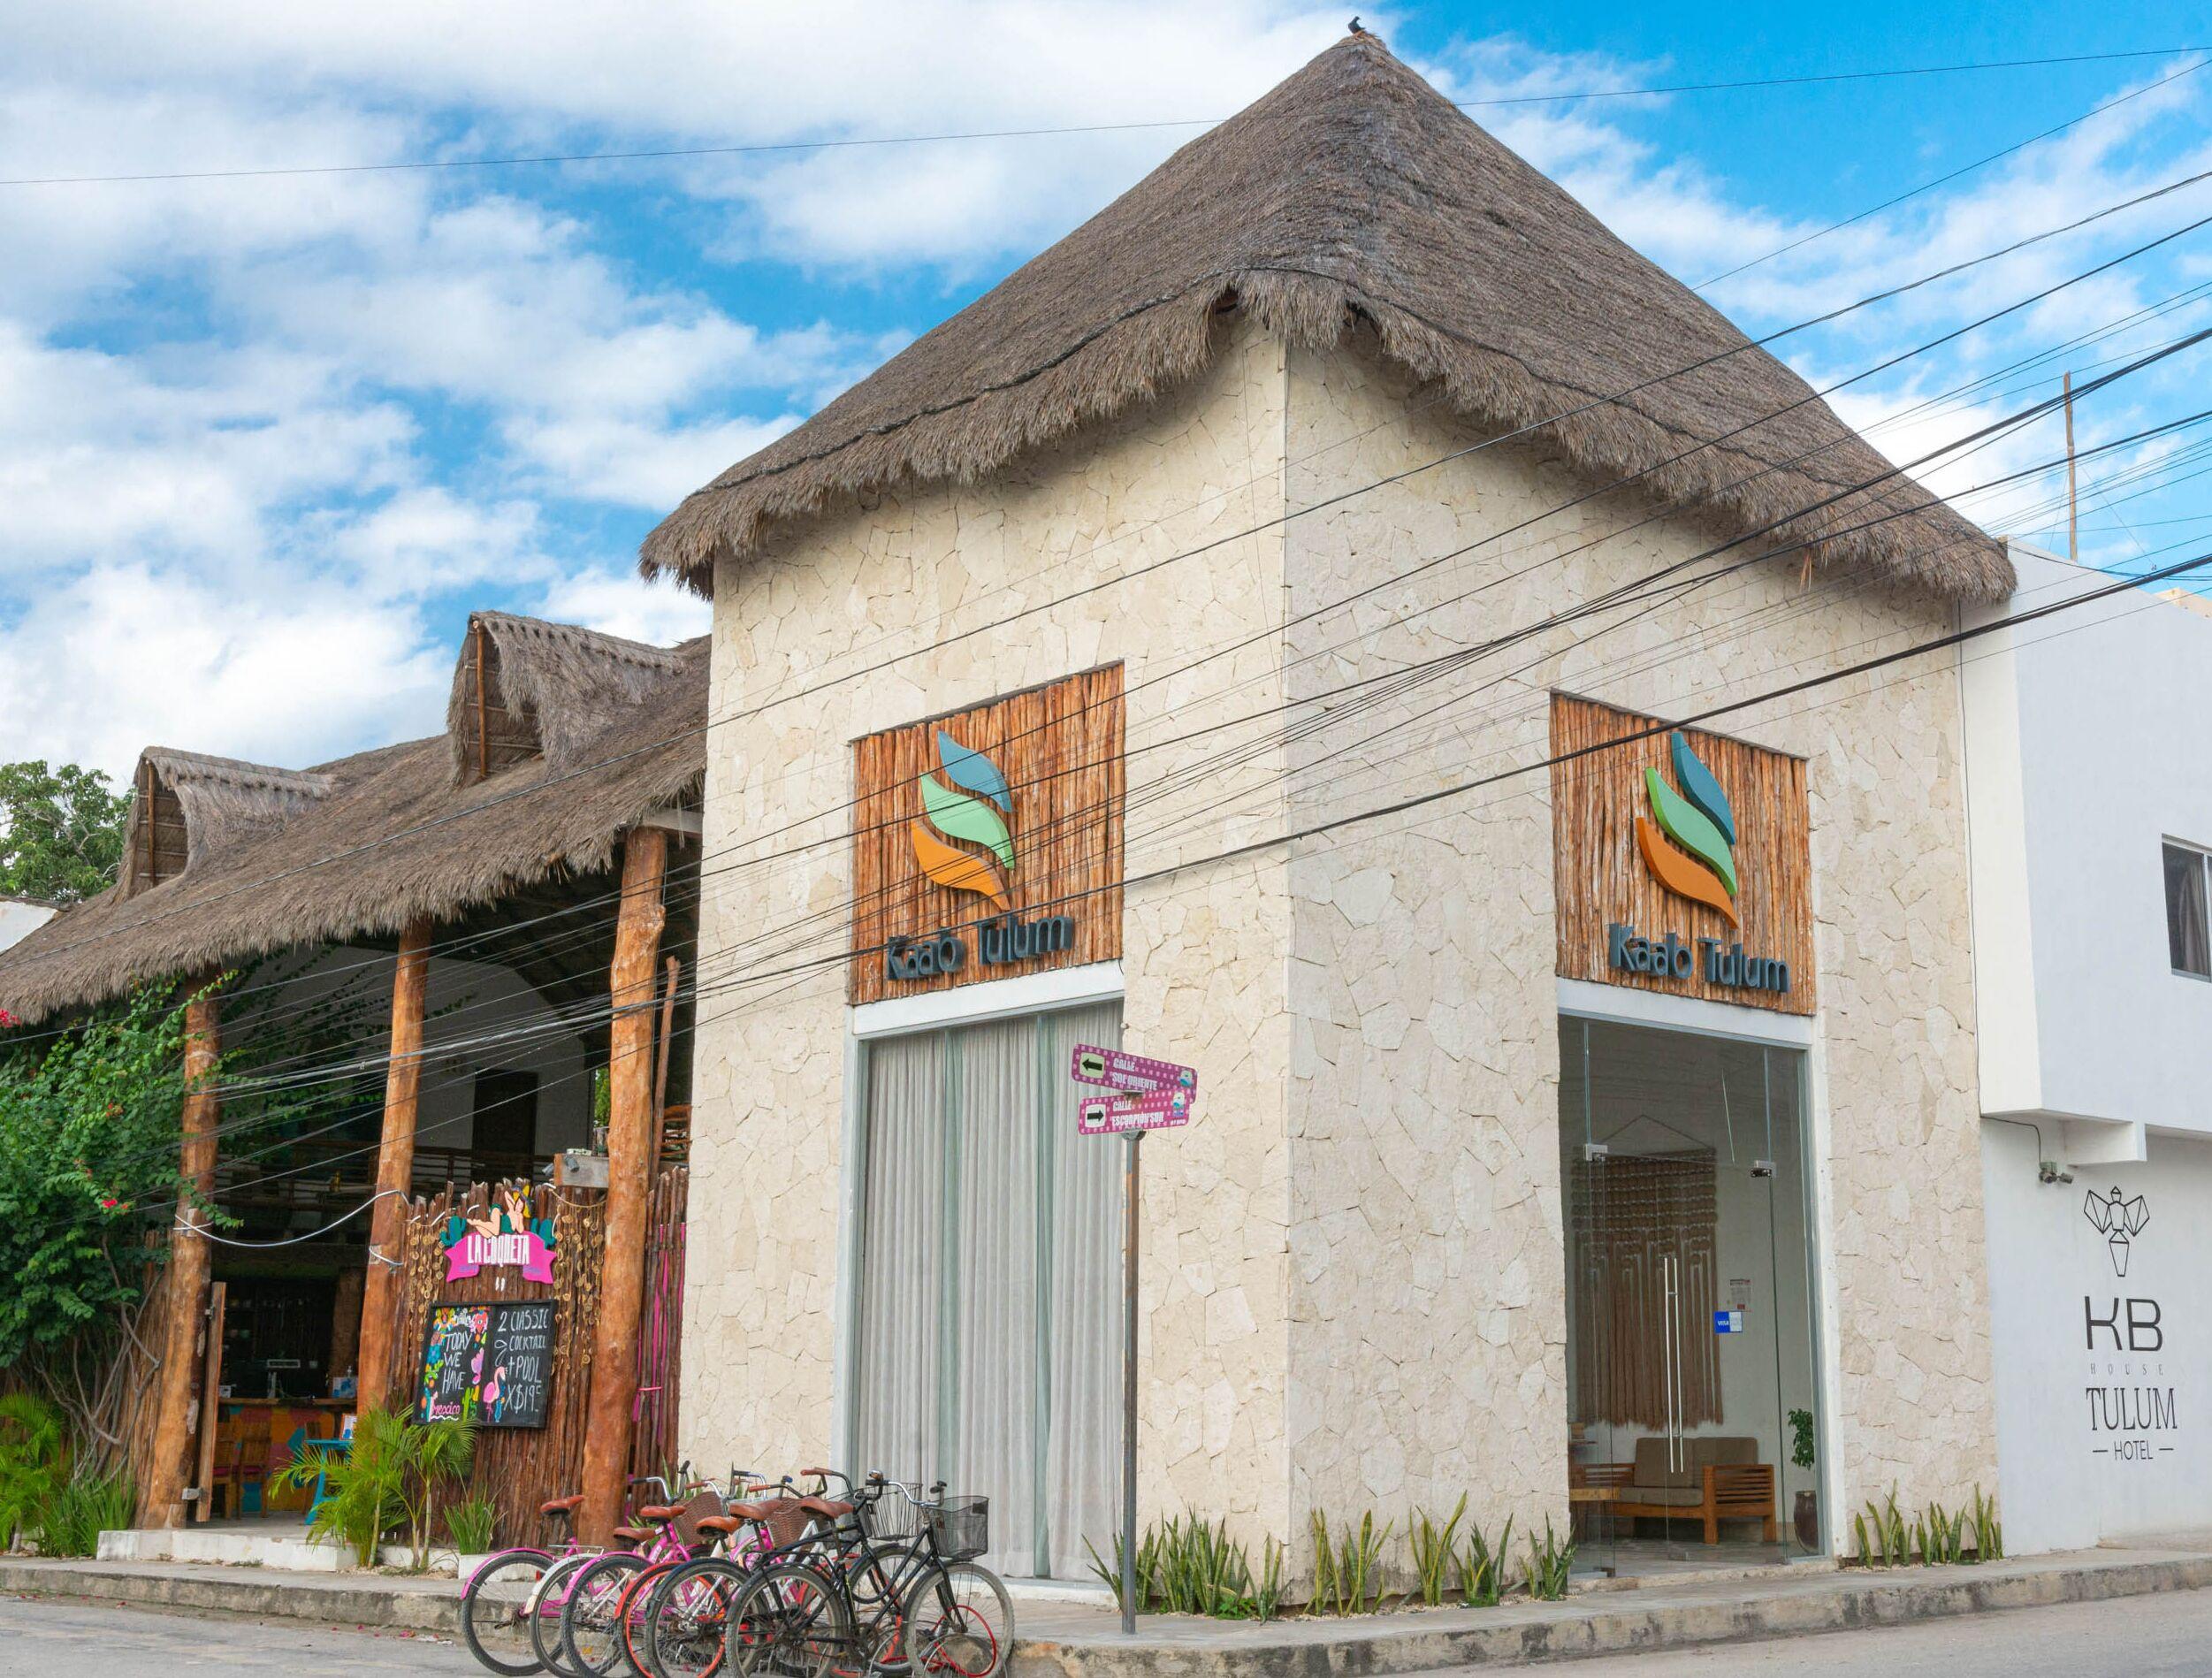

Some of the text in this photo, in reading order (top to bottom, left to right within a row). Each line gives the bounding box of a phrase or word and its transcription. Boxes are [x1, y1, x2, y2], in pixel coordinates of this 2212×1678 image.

[889, 913, 1072, 980] Kaab Tulum
[1609, 923, 1790, 993] Kaab Tulum
[1113, 1057, 1135, 1072] CALLE
[1113, 1100, 1132, 1111] CALLE
[467, 1234, 530, 1268] LA COQUETA
[498, 1311, 507, 1332] 2
[2084, 1296, 2163, 1352] KB
[445, 1331, 473, 1353] TODAY
[508, 1335, 546, 1352] COCKTAIL
[444, 1352, 462, 1368] WE
[2090, 1362, 2163, 1376] HOUSE
[442, 1368, 466, 1394] HAVE
[2086, 1387, 2178, 1430] TULUM
[2114, 1440, 2154, 1461] HOTEL
